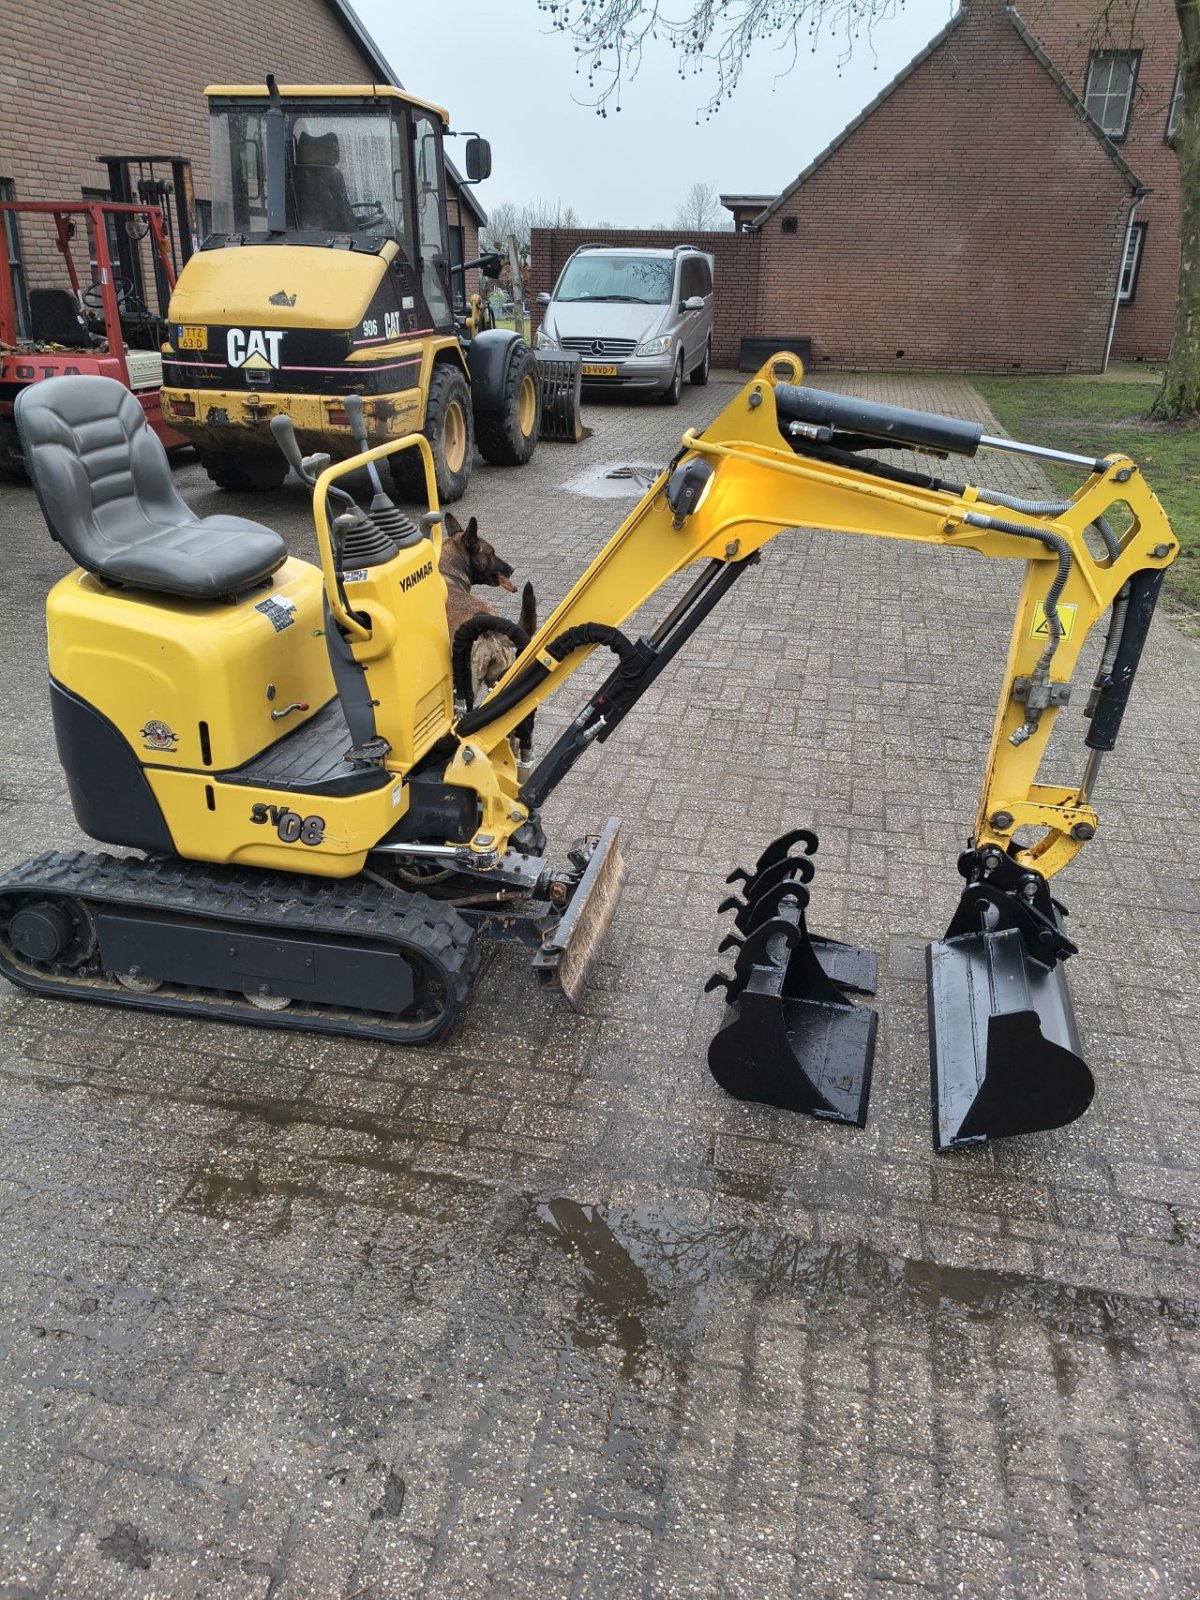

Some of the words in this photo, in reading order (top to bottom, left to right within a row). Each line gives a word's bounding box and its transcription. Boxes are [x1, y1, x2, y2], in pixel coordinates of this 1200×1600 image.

[186, 328, 202, 338] TTZ
[384, 311, 400, 339] CAT
[227, 328, 283, 369] CAT
[399, 561, 434, 593] YANMAR
